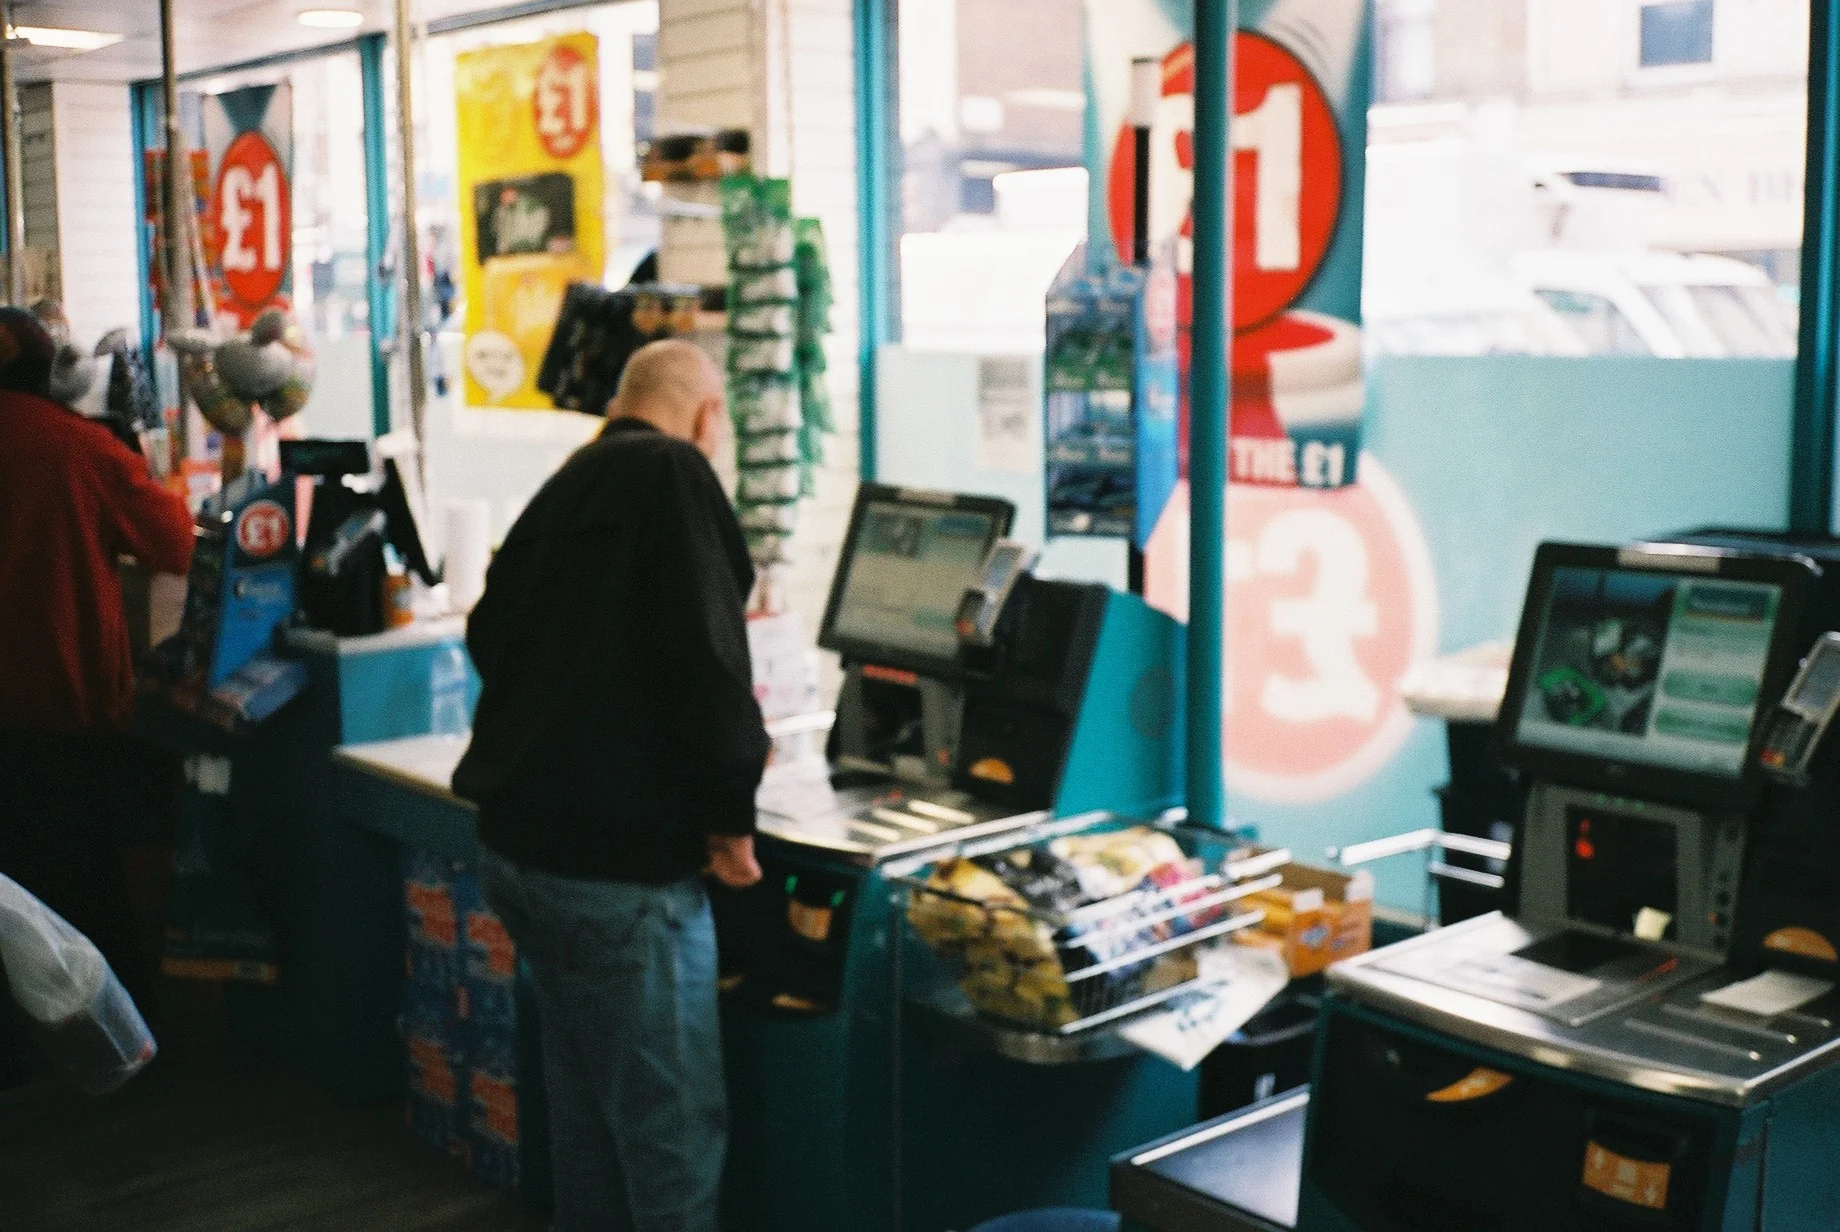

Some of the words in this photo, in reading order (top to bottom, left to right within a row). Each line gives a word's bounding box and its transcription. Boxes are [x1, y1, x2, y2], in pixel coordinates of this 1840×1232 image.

[540, 61, 587, 133] £1
[221, 162, 283, 271] £1
[1302, 440, 1346, 486] £1
[246, 516, 281, 547] £1
